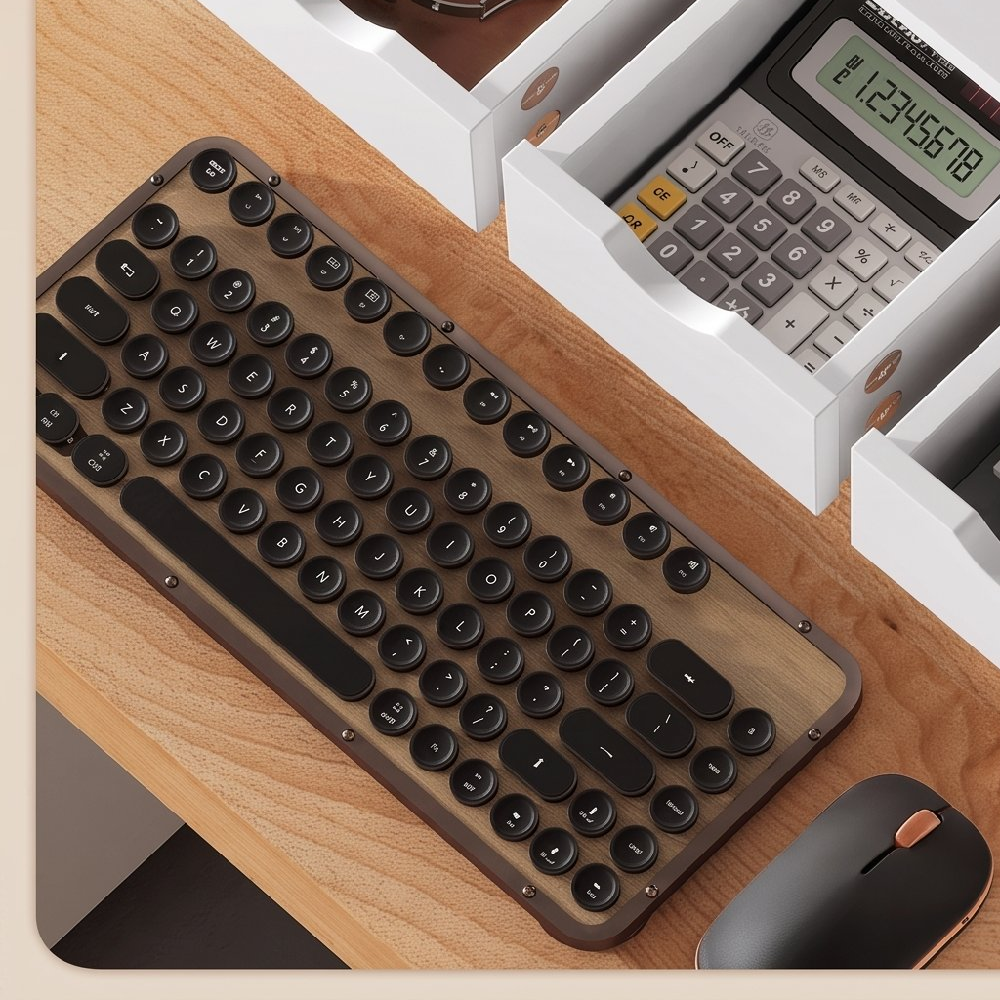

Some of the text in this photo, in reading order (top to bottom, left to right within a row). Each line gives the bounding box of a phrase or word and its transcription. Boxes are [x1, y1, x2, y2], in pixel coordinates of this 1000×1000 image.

[709, 131, 735, 149] OFF
[747, 161, 769, 174] 7
[719, 191, 738, 205] 4
[782, 190, 801, 206] 8
[690, 219, 708, 231] 1
[753, 218, 772, 232] 5
[815, 218, 836, 234] 9
[659, 243, 678, 259] 0
[722, 245, 742, 261] 2
[787, 246, 807, 262] 6
[186, 258, 194, 267] 1
[758, 272, 777, 288] 3
[223, 290, 233, 300] 2
[170, 306, 182, 317] Q
[260, 323, 271, 333] 3
[206, 336, 222, 350] W
[138, 351, 150, 361] A
[245, 371, 259, 383] E
[177, 383, 188, 394] S
[339, 389, 350, 398] 5
[120, 402, 134, 415] Z
[284, 403, 297, 416] R
[215, 415, 229, 427] D
[379, 423, 390, 432] 6
[157, 434, 172, 447] X
[325, 436, 337, 447] T
[254, 449, 267, 458] F
[418, 457, 430, 466] 7
[198, 470, 211, 480] C
[365, 471, 377, 481] Y
[294, 482, 308, 494] G
[458, 491, 469, 500] 8
[238, 503, 251, 514] V
[404, 504, 418, 517] U
[332, 515, 347, 528] H
[496, 525, 507, 534] 9
[276, 537, 288, 548] B
[374, 552, 386, 561] J
[538, 560, 548, 569] 0
[315, 570, 330, 584] N
[485, 573, 497, 585] O
[413, 585, 427, 598] K
[354, 604, 370, 619] M
[524, 608, 536, 617] P
[455, 620, 465, 632] L
